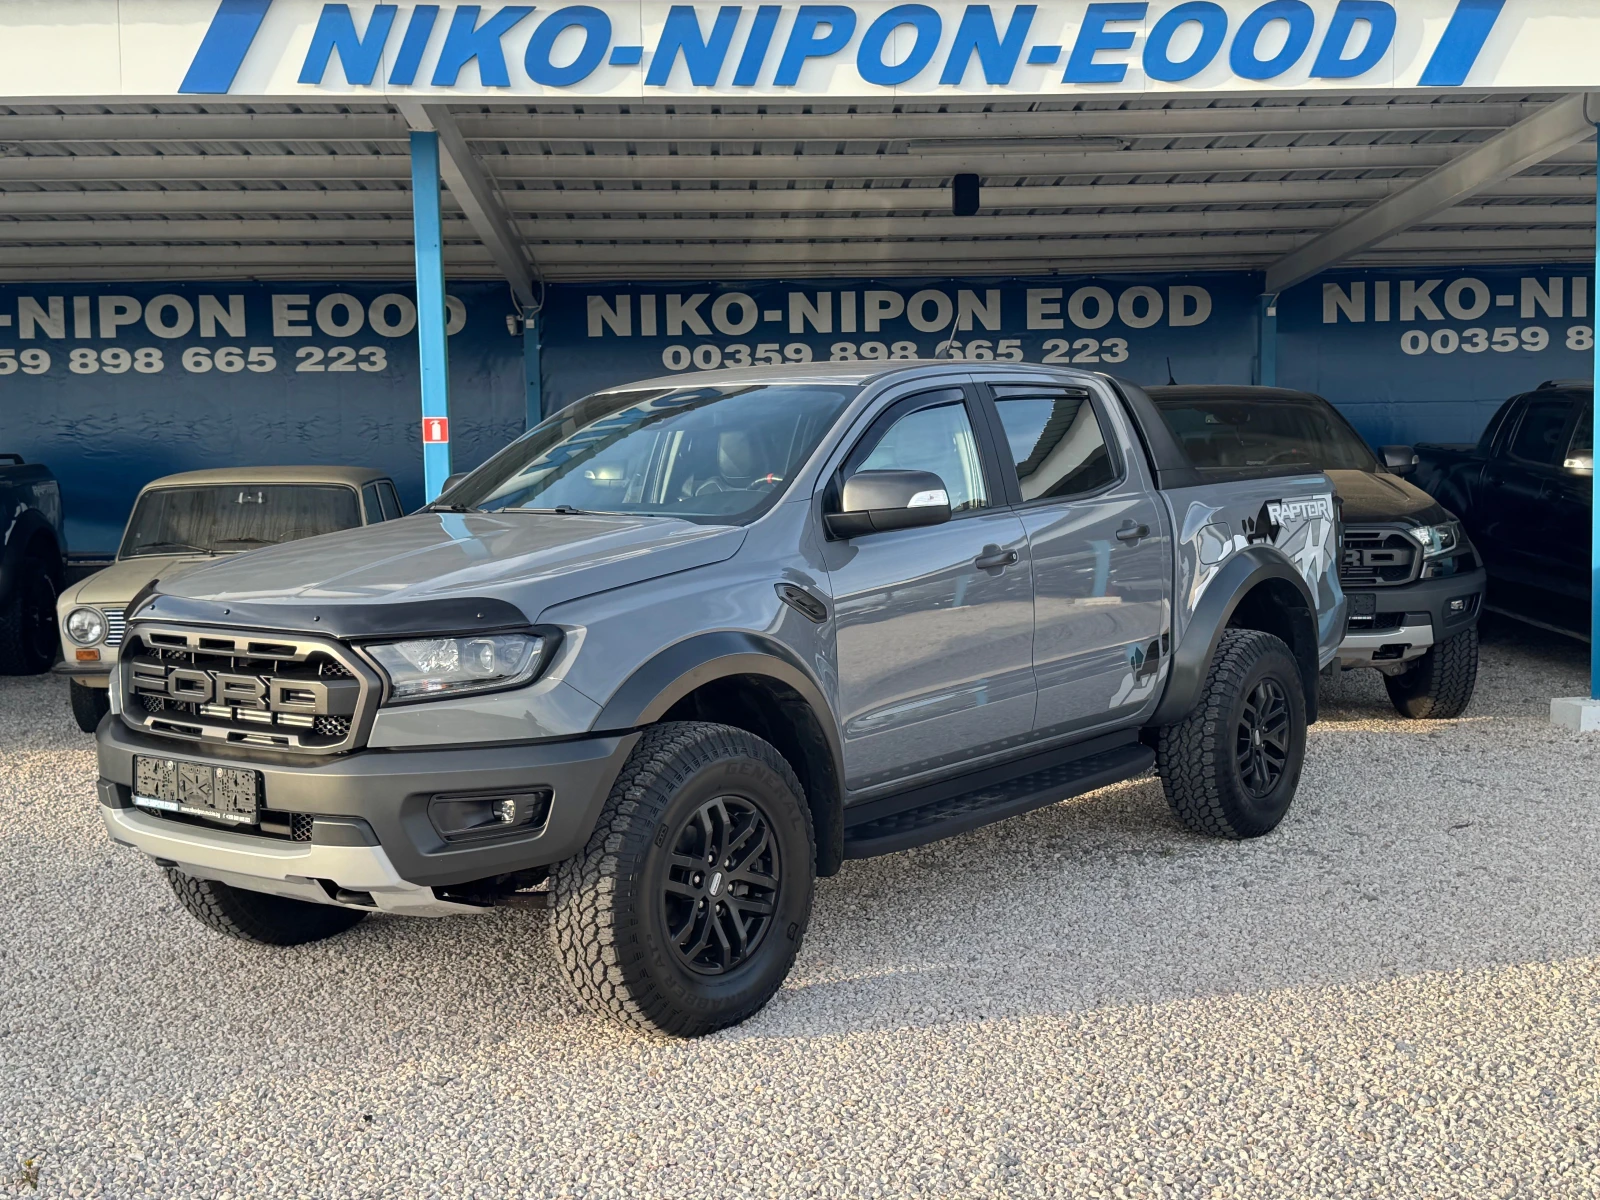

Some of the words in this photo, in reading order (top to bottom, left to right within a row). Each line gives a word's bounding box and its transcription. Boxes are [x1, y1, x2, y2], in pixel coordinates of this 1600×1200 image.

[297, 0, 1397, 87] NIKO-NIPON-EOOD
[586, 289, 1002, 338] NIKO-NIPON
[1025, 284, 1213, 331] EOOD
[662, 342, 813, 371] 00359
[829, 340, 919, 361] 898
[1041, 337, 1130, 364] 223
[1400, 325, 1550, 356] 00359
[68, 346, 165, 374] 898
[181, 346, 277, 373] 665
[295, 345, 388, 373] 223
[1266, 500, 1331, 531] RAPTOR
[130, 661, 328, 715] FORD
